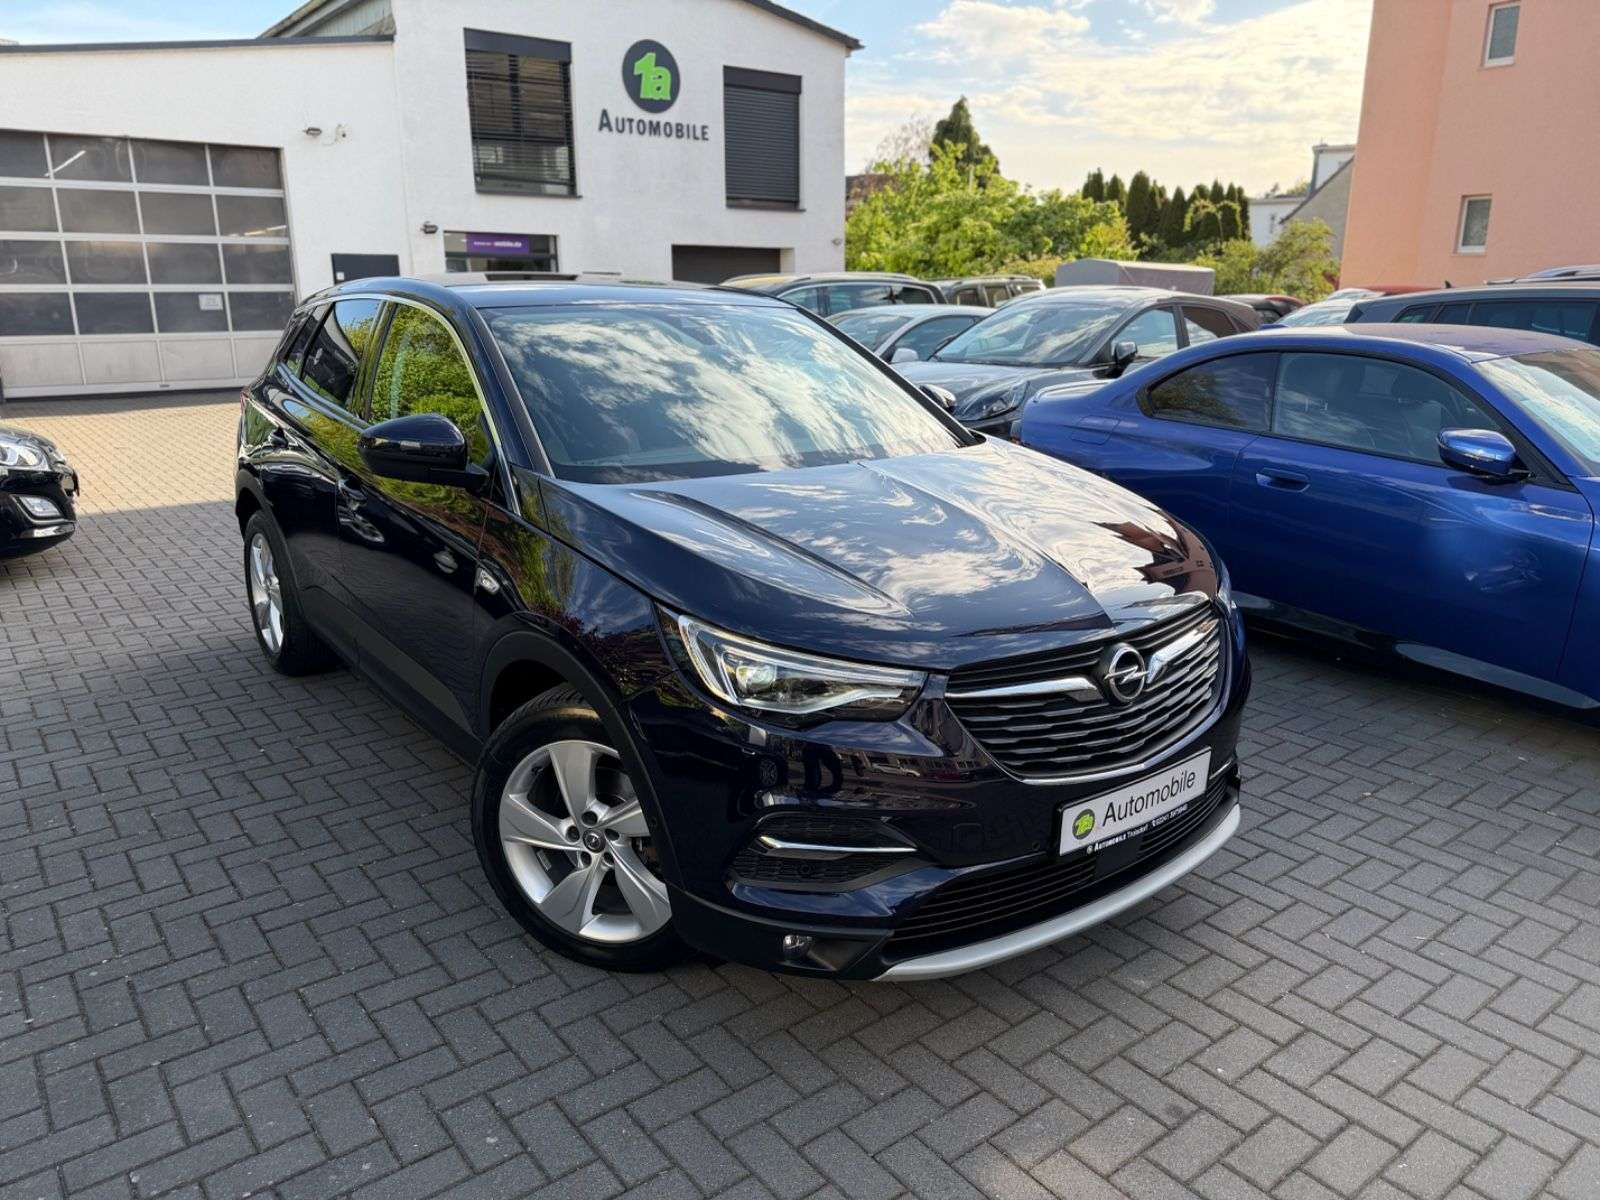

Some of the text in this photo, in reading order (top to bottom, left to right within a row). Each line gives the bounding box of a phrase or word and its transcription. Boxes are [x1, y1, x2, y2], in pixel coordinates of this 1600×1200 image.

[633, 52, 672, 101] 1a
[598, 108, 710, 141] AUTOMOBILE
[1102, 771, 1196, 827] Automobile
